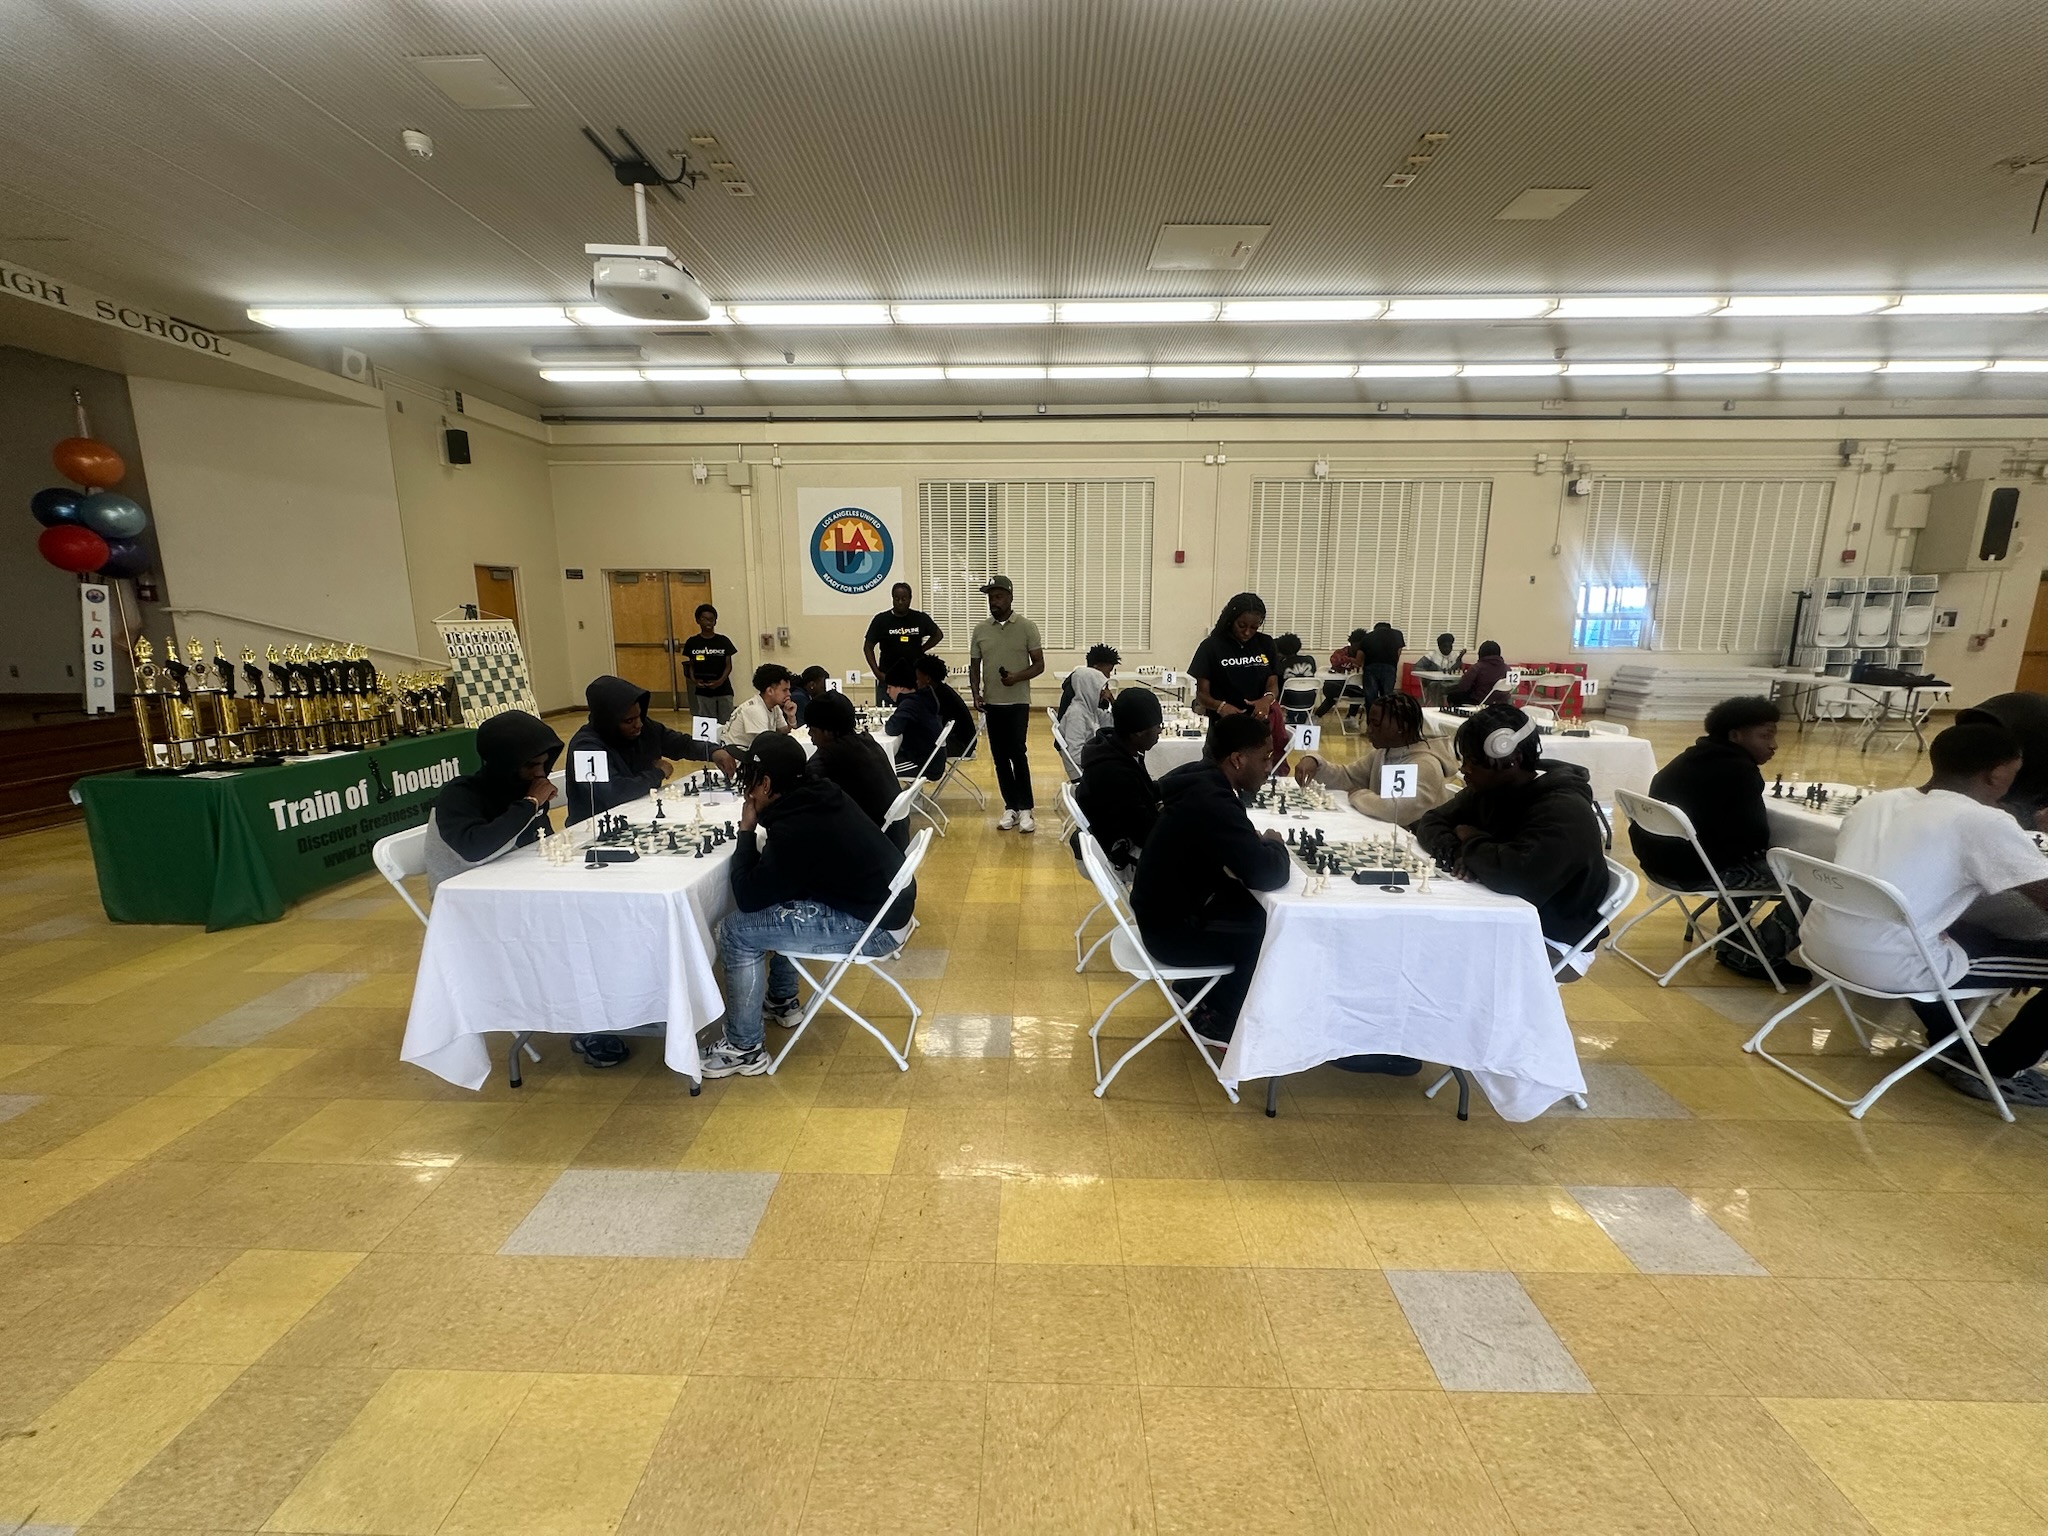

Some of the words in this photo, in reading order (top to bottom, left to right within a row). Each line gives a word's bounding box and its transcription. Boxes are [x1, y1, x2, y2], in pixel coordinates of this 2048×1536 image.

[95, 300, 232, 357] SCHOOL
[822, 516, 834, 528] LOS
[832, 510, 860, 519] ANGELES
[860, 512, 881, 529] UNIFIED
[822, 573, 841, 589] READY
[840, 584, 852, 593] FOR
[863, 574, 883, 590] WORLD
[831, 681, 837, 690] 3
[851, 672, 856, 682] 4
[1166, 673, 1172, 683] 8
[1508, 673, 1519, 683] 12
[1584, 682, 1595, 693] 11
[701, 722, 709, 737] 2
[1303, 729, 1312, 746] 6
[587, 756, 595, 776] 1
[1393, 769, 1406, 792] 5
[268, 789, 342, 832] Train
[345, 778, 369, 810] of
[297, 823, 358, 854] Discover
[360, 802, 420, 834] Greatness
[1812, 868, 1845, 890] GHS
